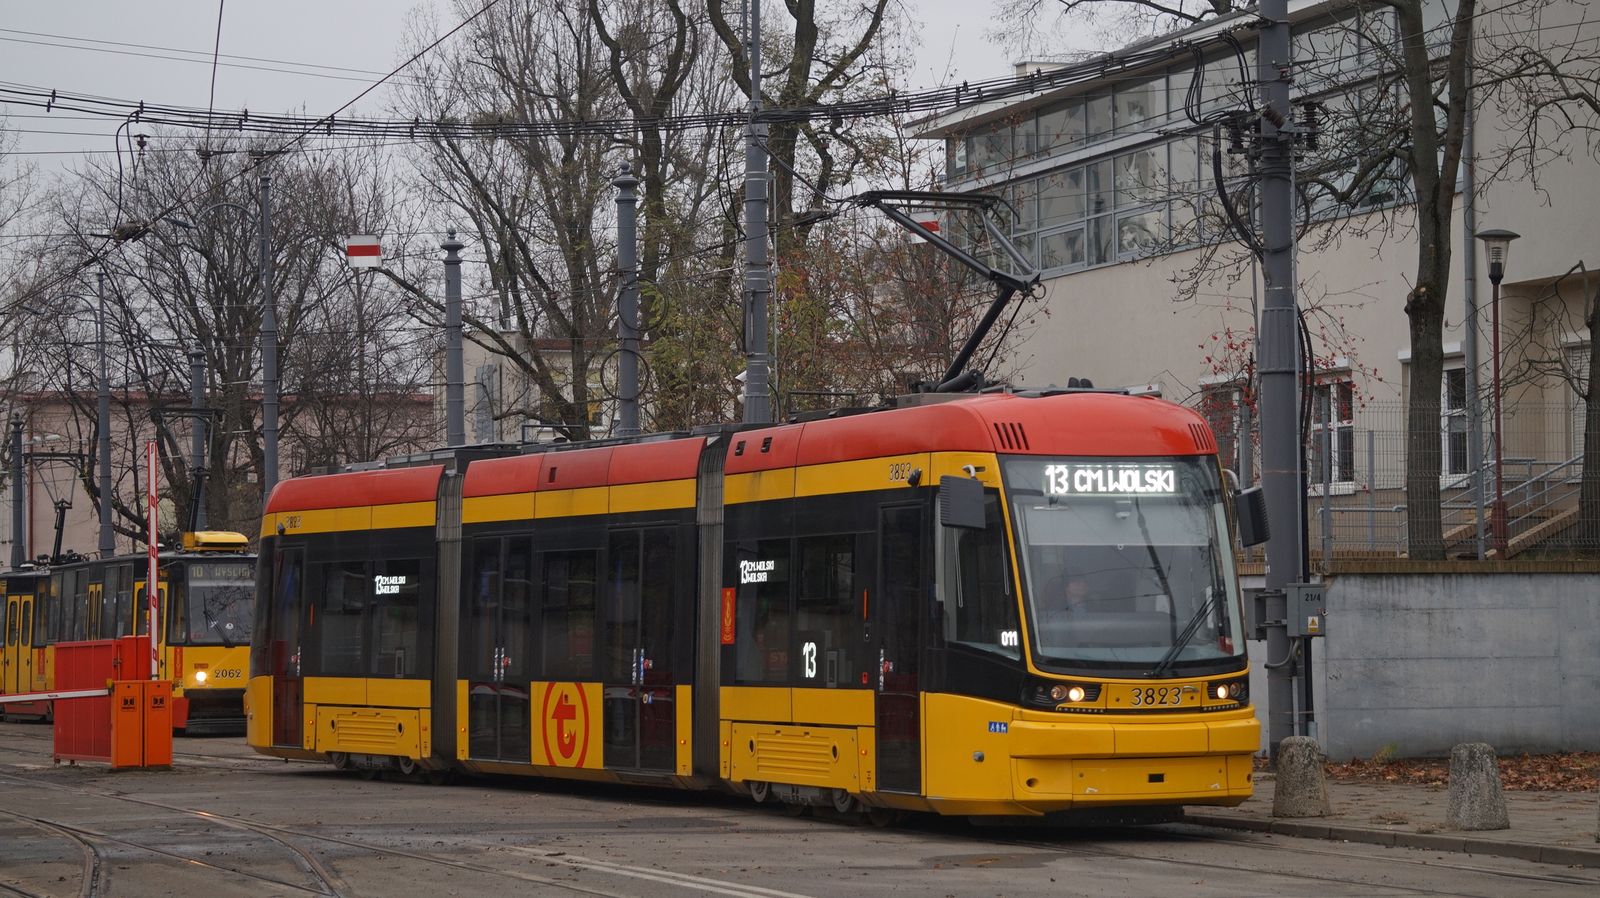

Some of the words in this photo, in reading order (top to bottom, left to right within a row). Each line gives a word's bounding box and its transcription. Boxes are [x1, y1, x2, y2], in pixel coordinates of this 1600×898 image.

[1045, 464, 1069, 494] 13
[191, 566, 204, 578] 10
[740, 559, 748, 584] 13
[1304, 593, 1321, 602] 21/4
[1001, 630, 1019, 647] 011
[802, 642, 817, 678] 13
[214, 669, 241, 679] 2062
[1130, 687, 1182, 706] 3823
